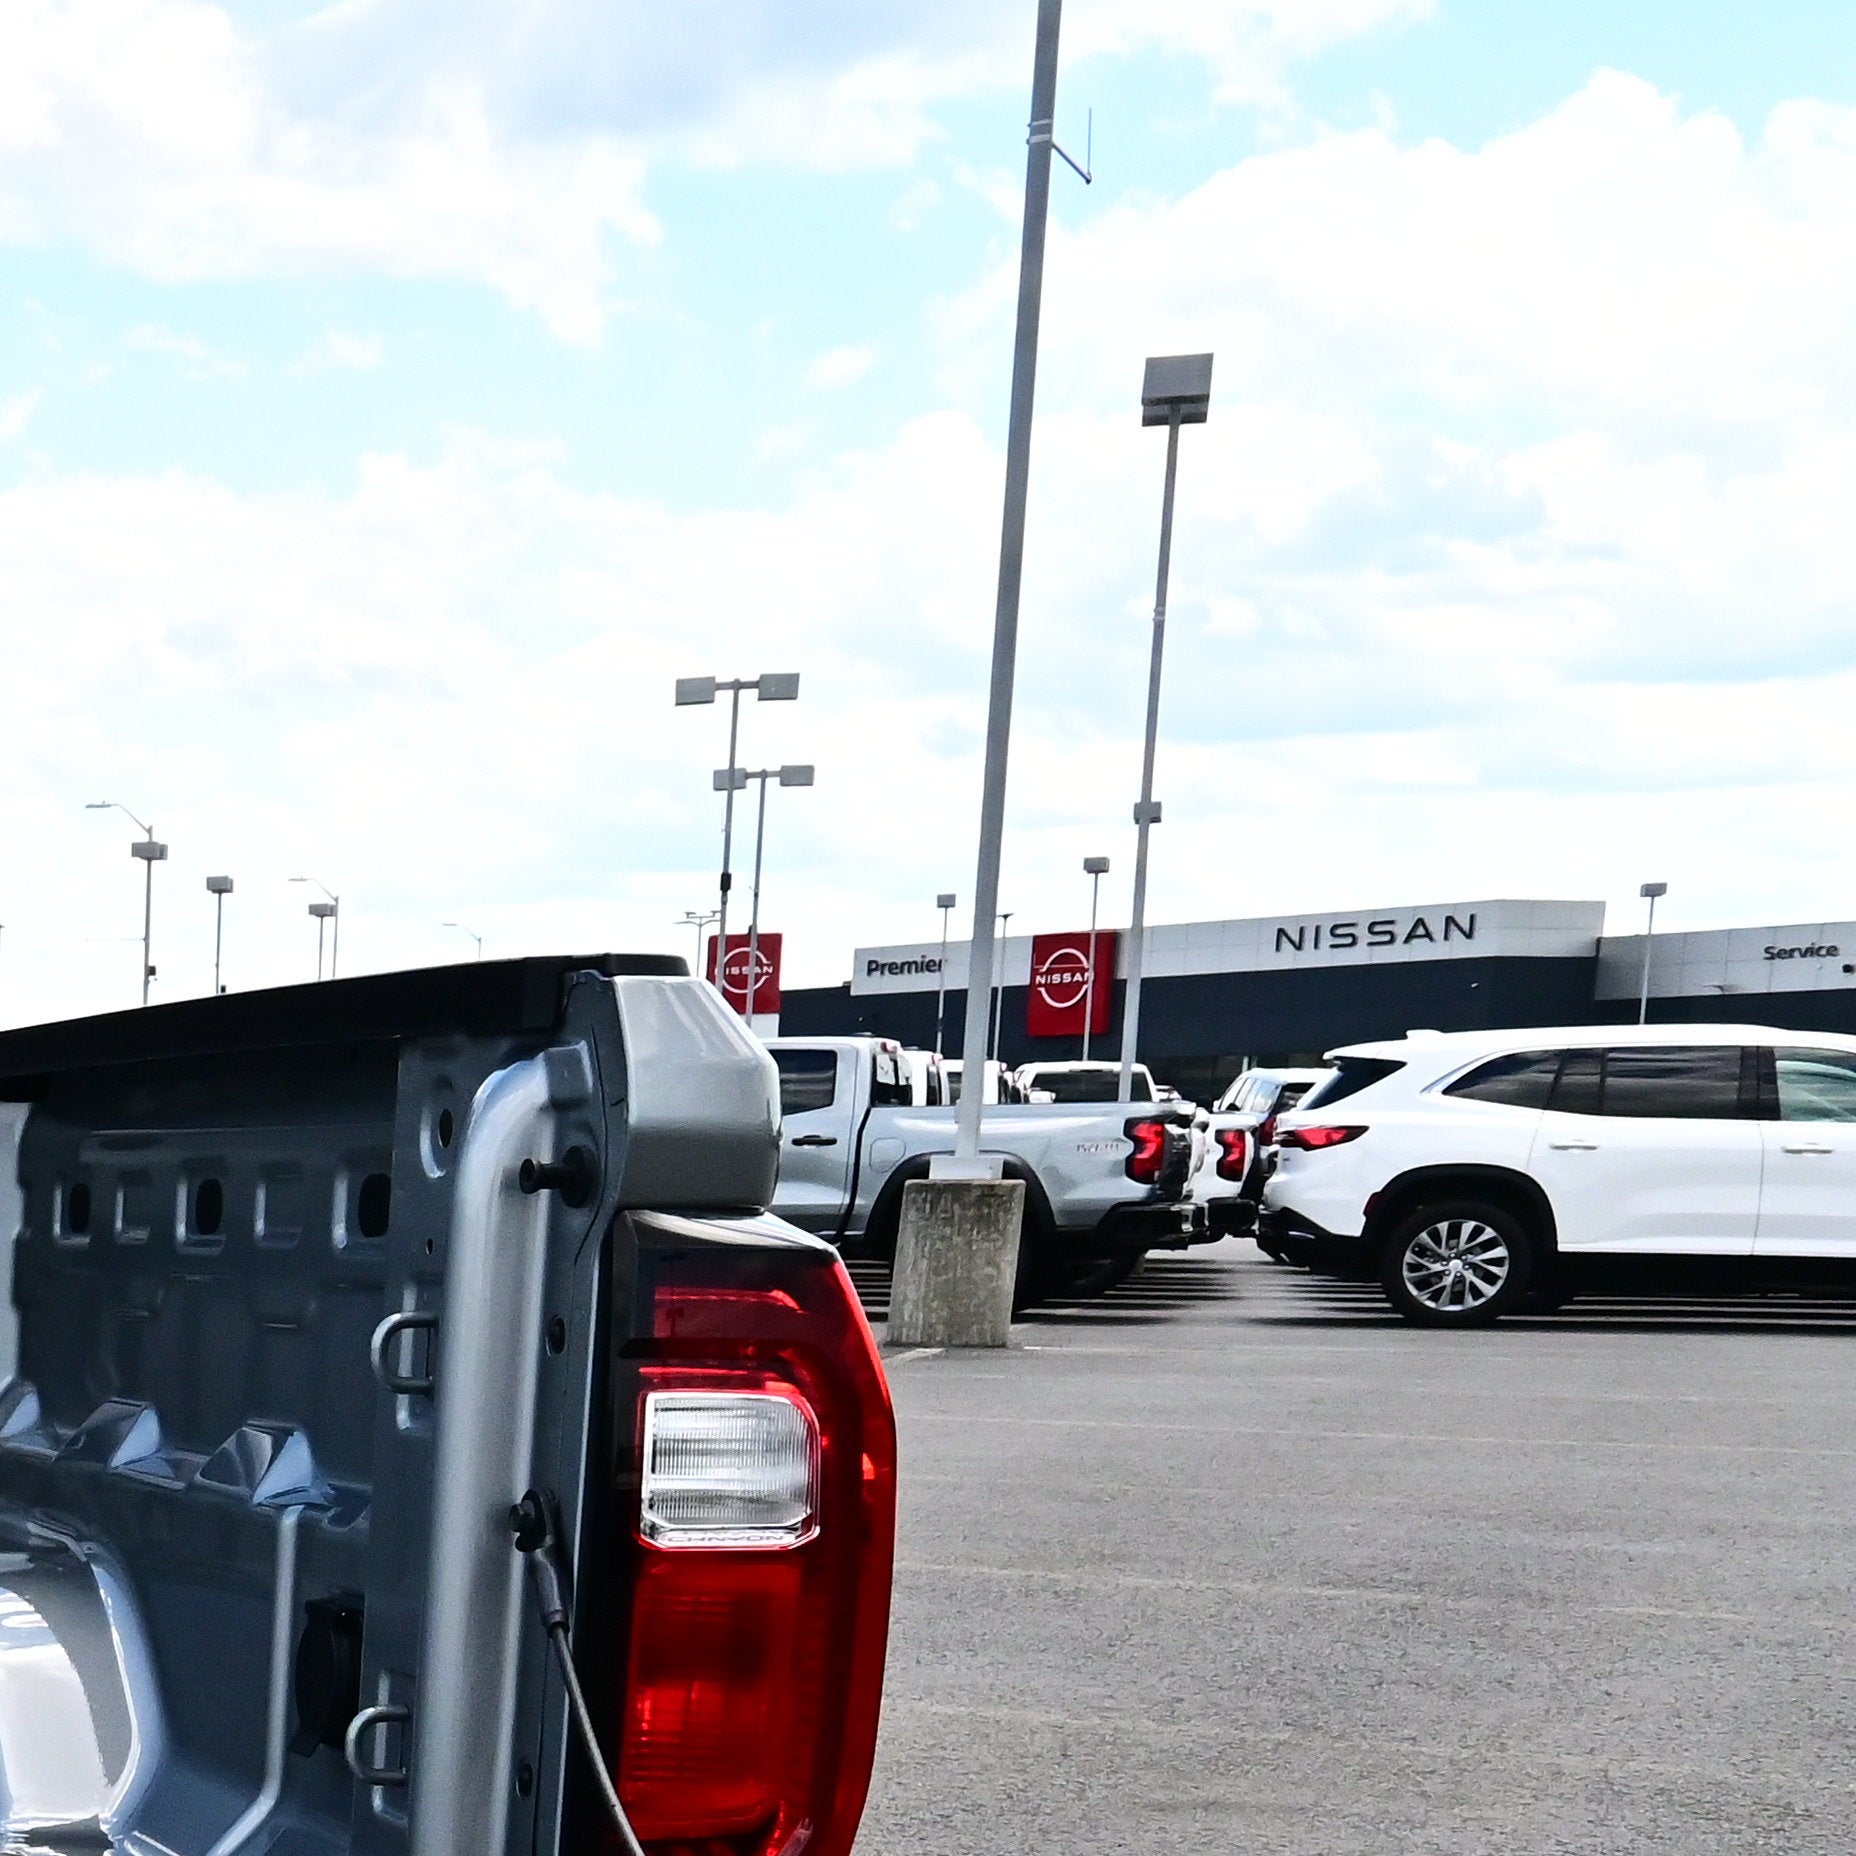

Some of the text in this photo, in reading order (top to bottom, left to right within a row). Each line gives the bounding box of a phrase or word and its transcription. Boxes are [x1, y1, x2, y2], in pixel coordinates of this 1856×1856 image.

[1275, 913, 1477, 953] NISSAN
[1763, 942, 1840, 961] Service
[714, 966, 774, 976] ISSAN
[866, 954, 949, 977] Premier
